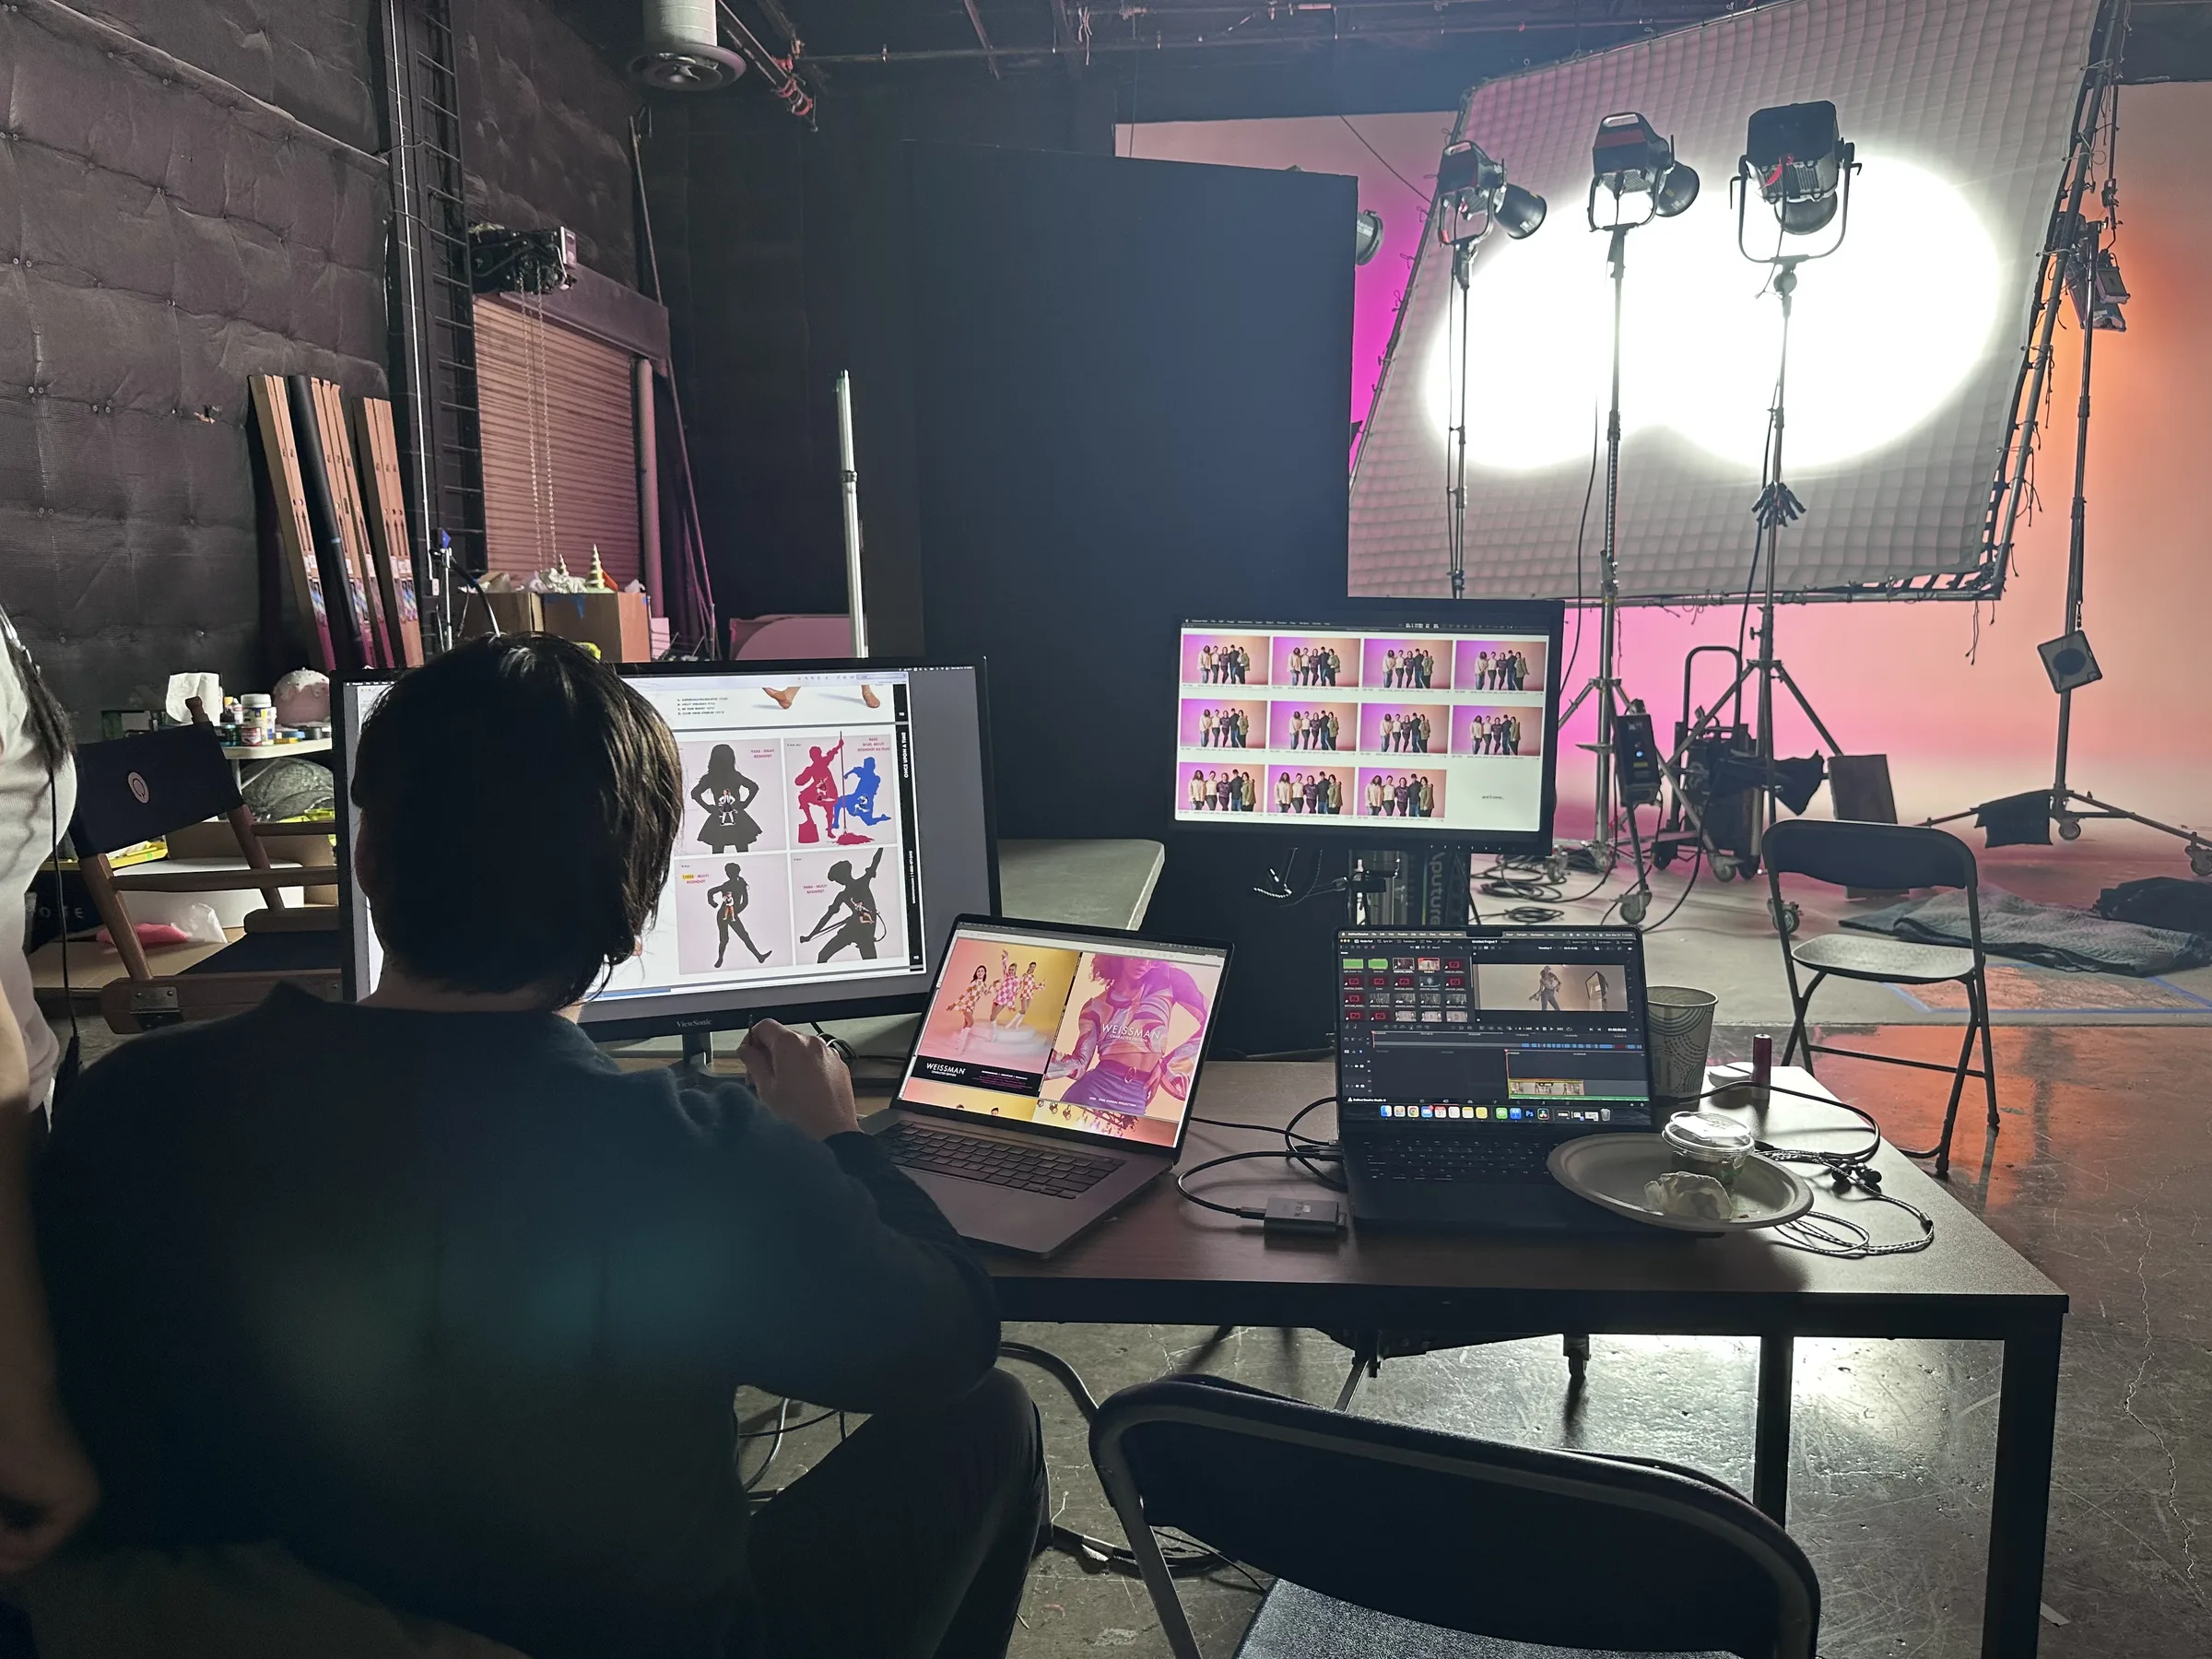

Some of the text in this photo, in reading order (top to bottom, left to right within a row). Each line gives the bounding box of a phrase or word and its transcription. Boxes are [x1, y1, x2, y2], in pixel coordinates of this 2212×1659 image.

[676, 1018, 712, 1028] ViewSonic
[1102, 1023, 1161, 1040] WEISSMAN
[926, 1062, 966, 1076] WEISSMAN
